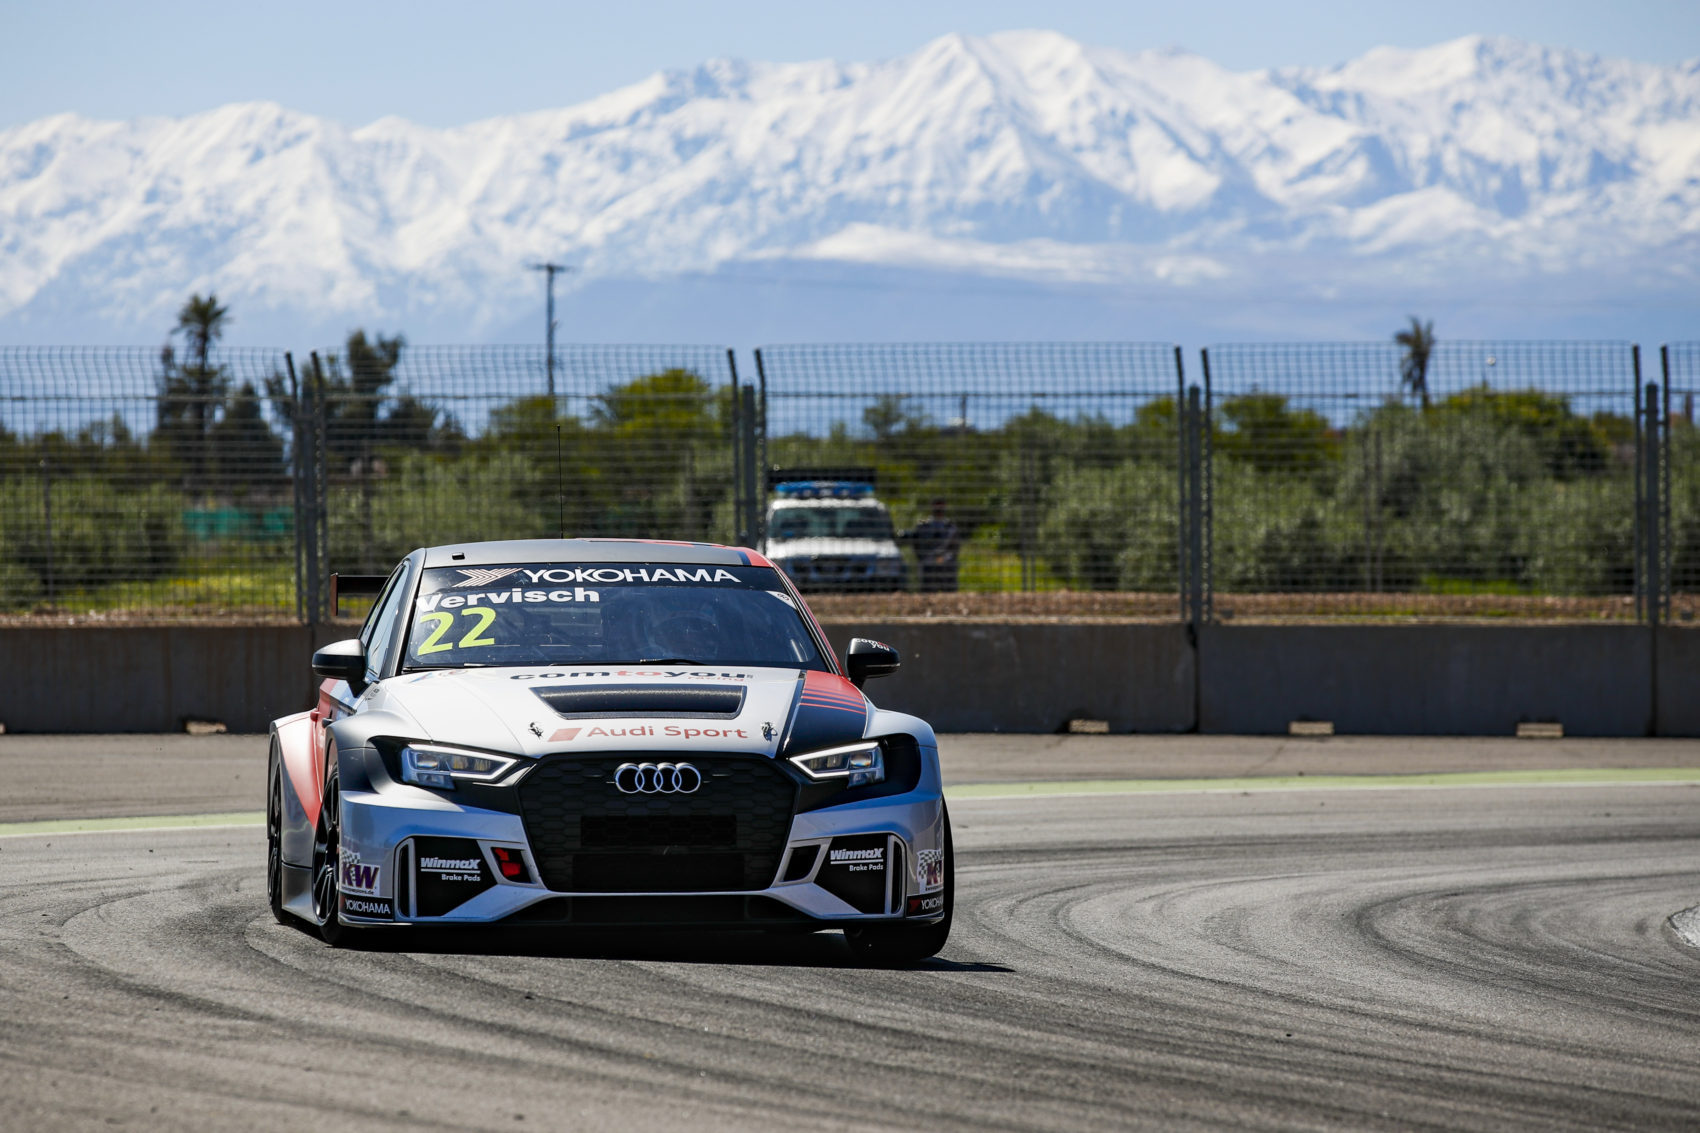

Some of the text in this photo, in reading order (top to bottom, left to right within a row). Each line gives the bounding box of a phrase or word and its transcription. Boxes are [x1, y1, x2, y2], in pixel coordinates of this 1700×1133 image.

[524, 568, 742, 583] YOKOHAMA
[416, 587, 600, 613] Vervisch
[417, 606, 496, 656] 22
[510, 670, 745, 680] comtoyou
[587, 725, 748, 740] Audi Sport
[849, 863, 883, 872] Brake Pads
[341, 863, 379, 889] KW
[441, 873, 481, 883] Brake Pads
[345, 900, 391, 914] YOKOHAMA
